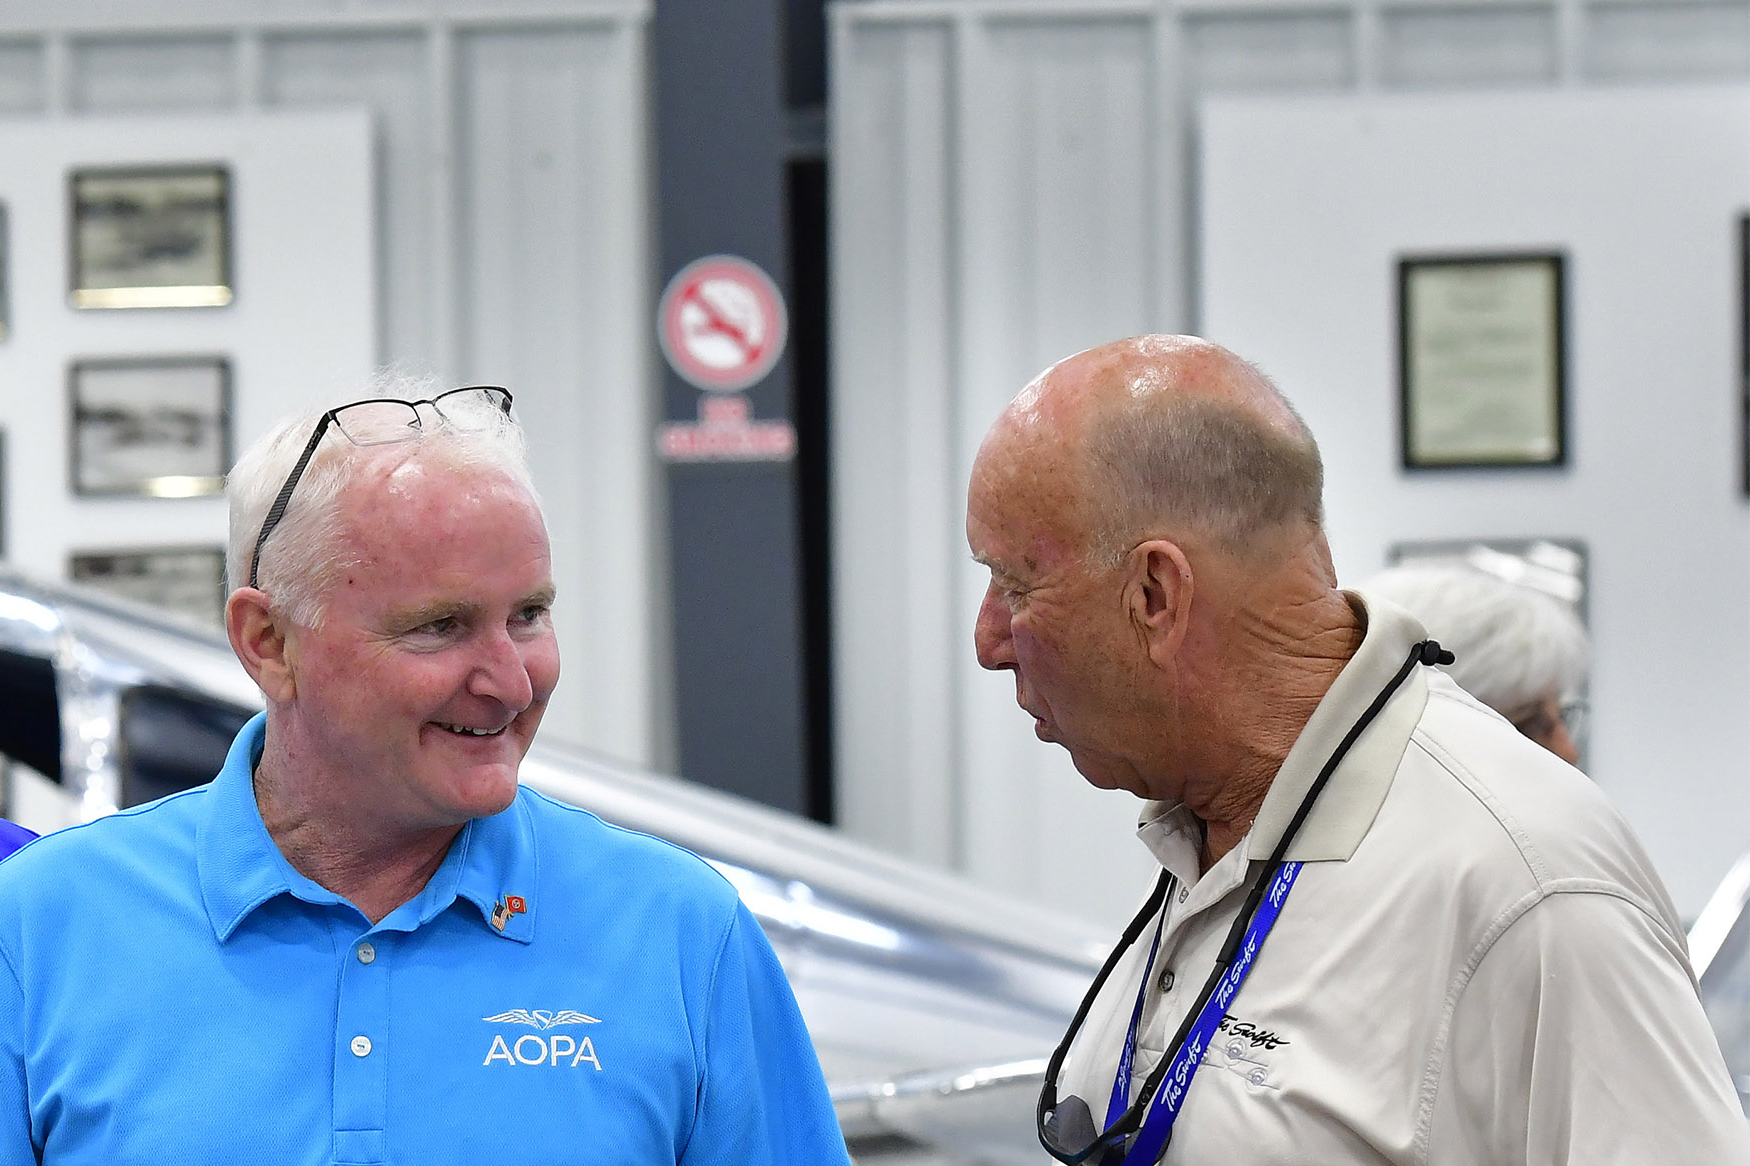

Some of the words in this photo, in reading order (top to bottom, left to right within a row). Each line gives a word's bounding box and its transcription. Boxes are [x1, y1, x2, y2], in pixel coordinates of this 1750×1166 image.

[1214, 978, 1234, 1010] The
[1230, 930, 1258, 985] Swift
[482, 1034, 602, 1071] AOPA
[1160, 1078, 1182, 1112] The
[1175, 1030, 1202, 1086] Swift
